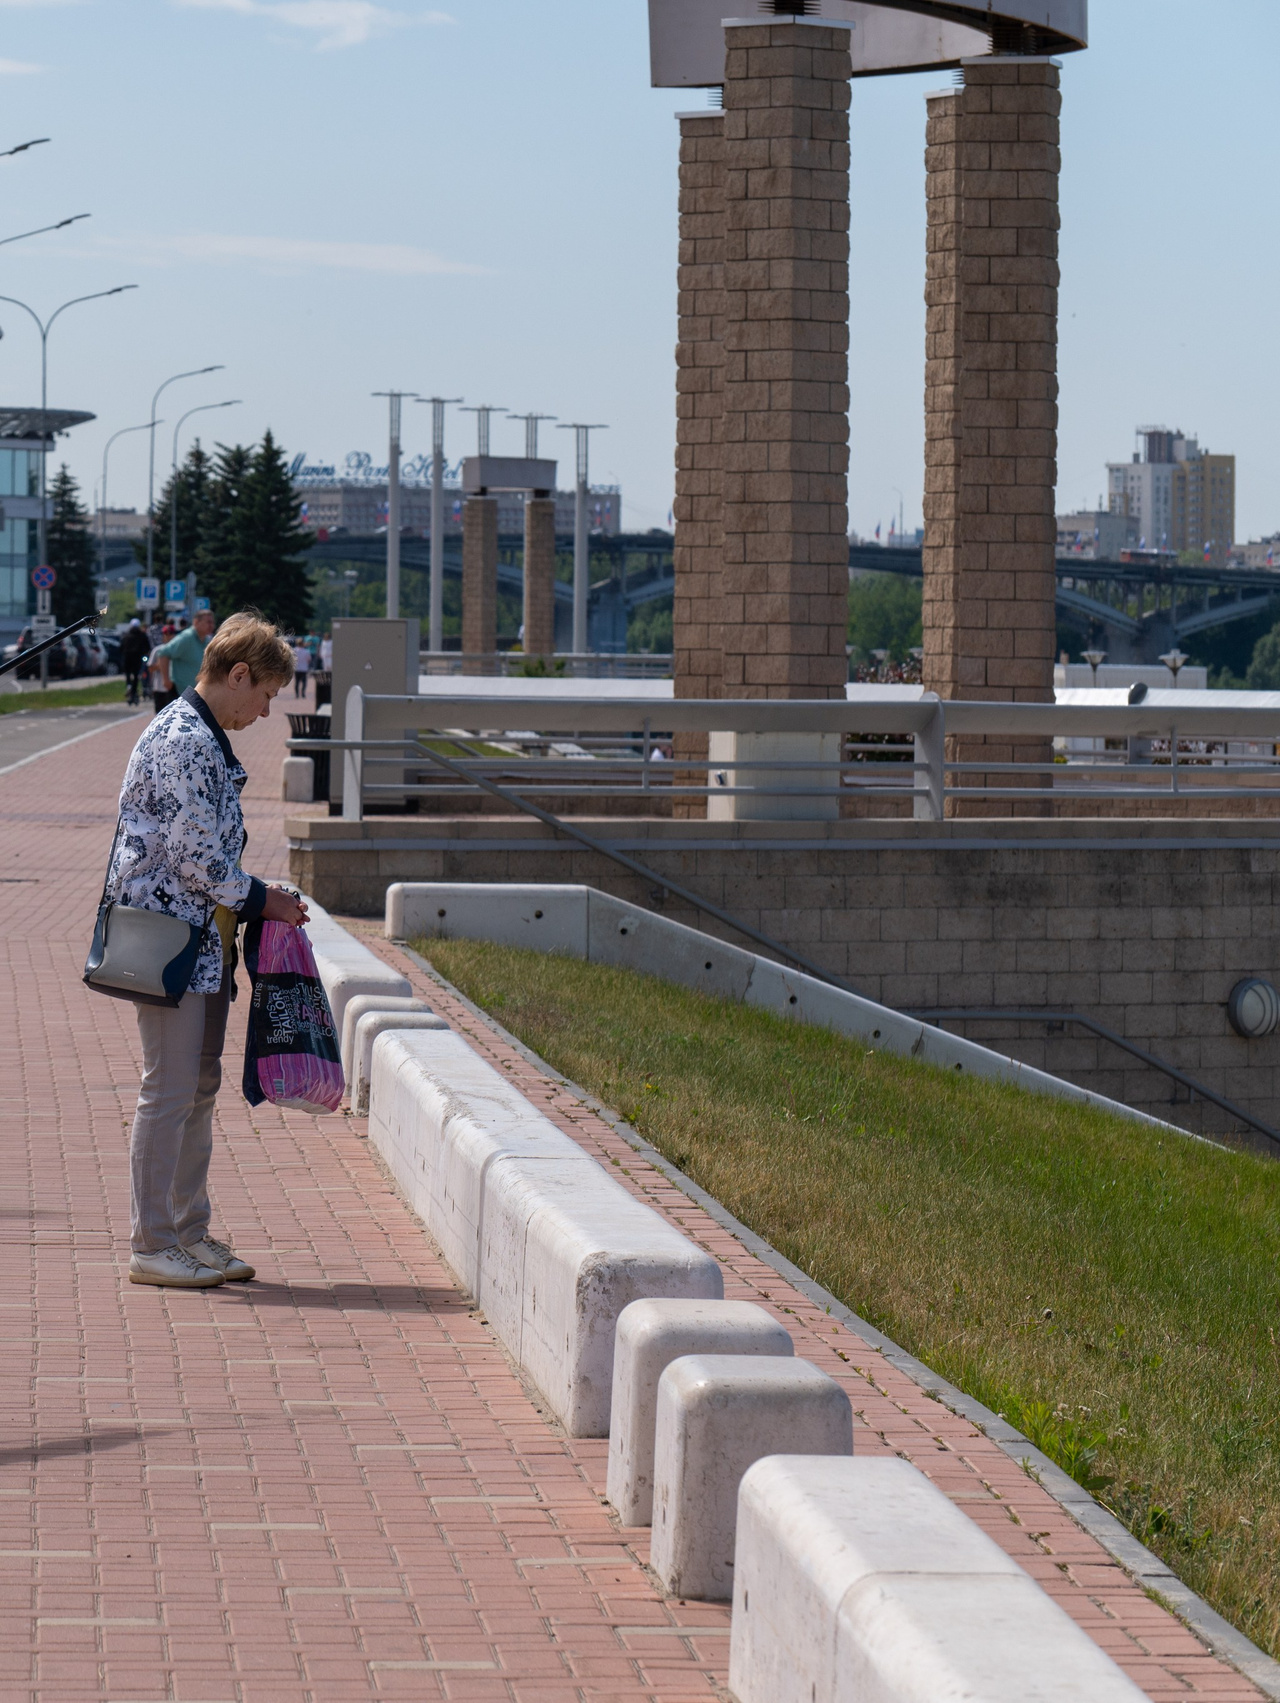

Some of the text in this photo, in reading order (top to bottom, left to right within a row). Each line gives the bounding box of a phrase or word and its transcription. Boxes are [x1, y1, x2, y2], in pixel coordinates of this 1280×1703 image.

[402, 453, 464, 480] Htel
[253, 982, 263, 1008] SUITS
[266, 1004, 283, 1037] SUITS
[272, 990, 293, 1036] TAILOR
[267, 1035, 295, 1045] trendy
